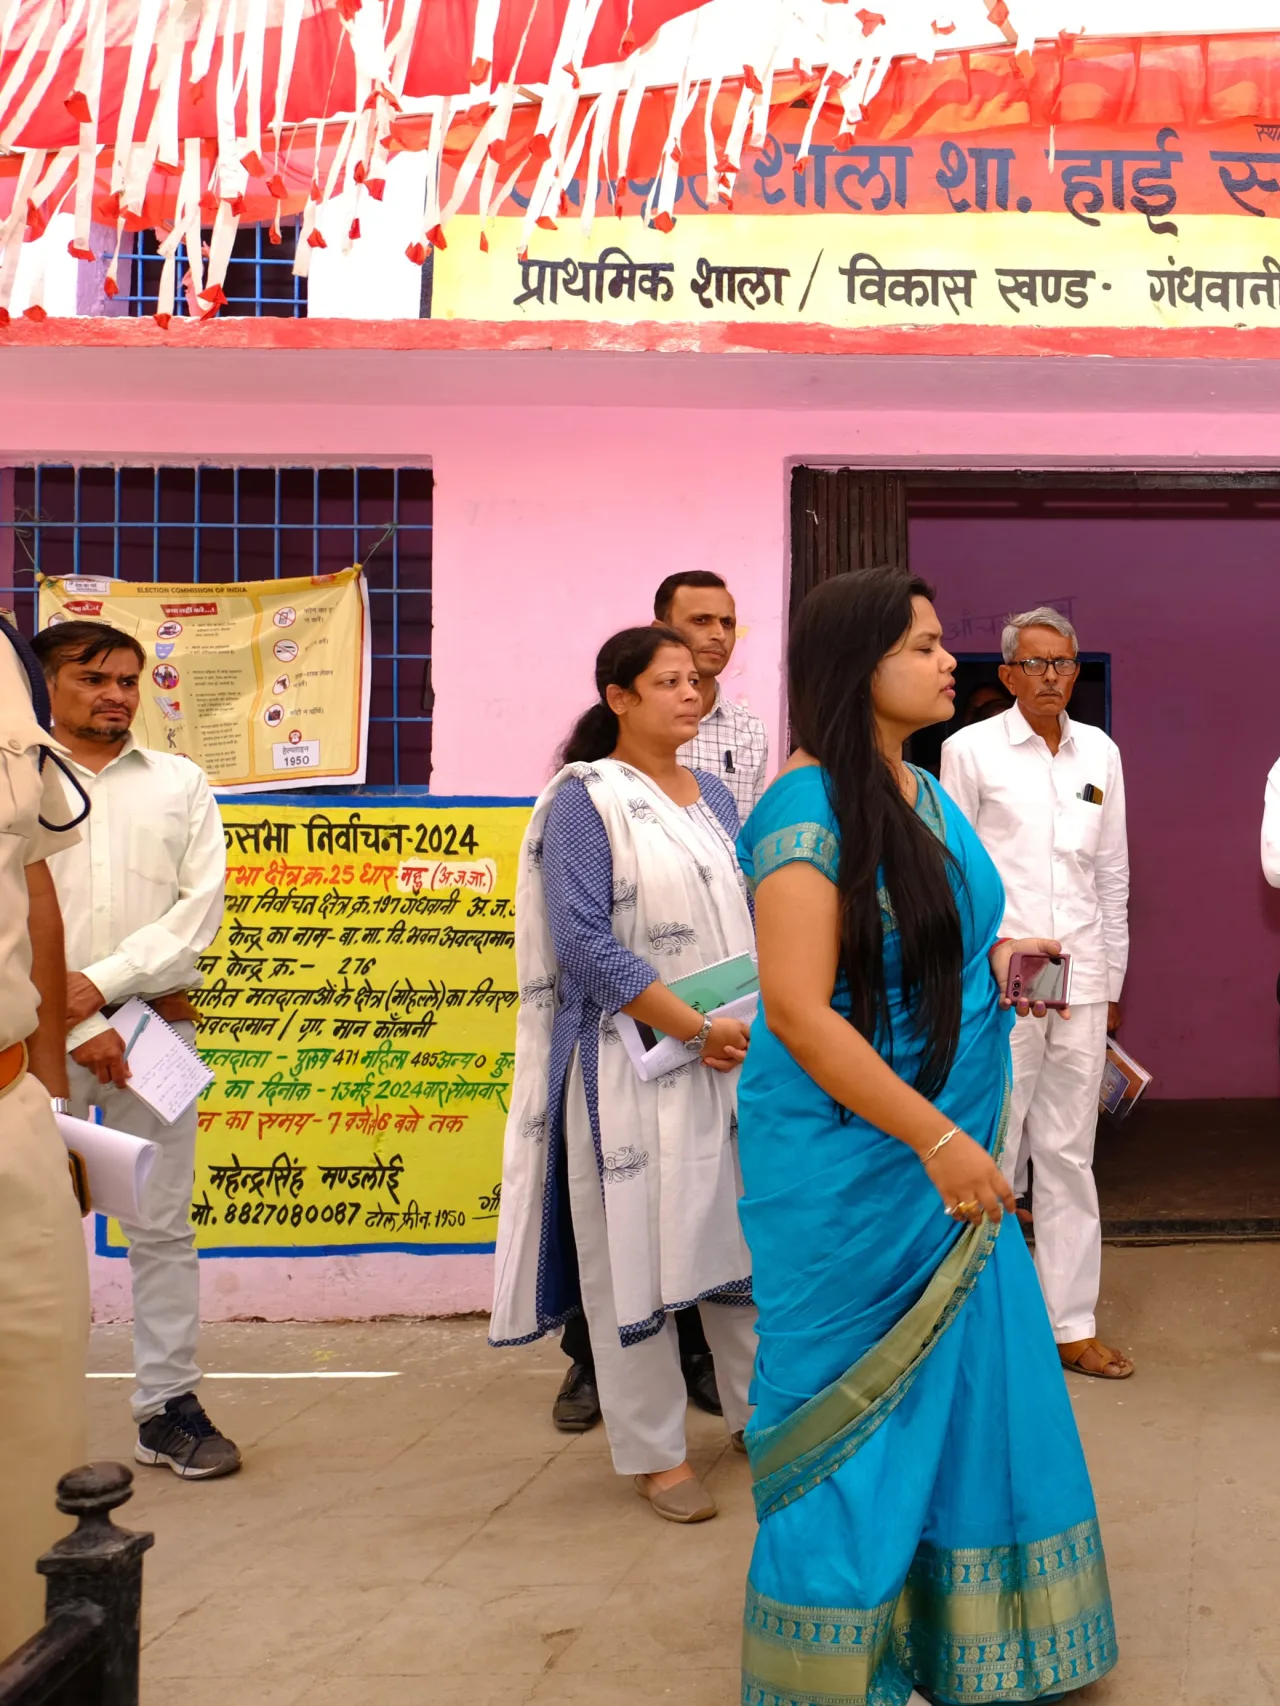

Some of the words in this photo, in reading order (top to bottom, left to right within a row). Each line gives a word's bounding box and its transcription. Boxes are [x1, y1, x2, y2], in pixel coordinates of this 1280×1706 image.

[936, 140, 1032, 213] शा.
[1045, 127, 1184, 237] हाई
[513, 247, 674, 306] प्राथमिक
[690, 257, 791, 310] शाला
[838, 253, 977, 315] विकास
[284, 756, 309, 766] 1950
[252, 887, 319, 915] निर्वाचन
[318, 887, 353, 919] क्षेत्र
[228, 917, 264, 953] केन्द्र
[267, 926, 294, 944] का
[226, 950, 268, 982] केन्द्र
[338, 957, 376, 975] 276
[445, 989, 469, 1007] का
[333, 1018, 372, 1040] मान
[332, 1049, 360, 1067] 471
[360, 1039, 410, 1075] महिला
[410, 1051, 438, 1067] 485
[225, 1080, 255, 1099] का
[374, 1080, 423, 1100] 2024
[225, 1110, 255, 1131] का
[377, 1112, 392, 1131] 6
[394, 1105, 425, 1133] बजे
[428, 1115, 469, 1133] तक
[317, 1152, 404, 1204] मण्डलोई
[224, 1201, 361, 1228] 8827080087
[434, 1209, 466, 1228] 1950
